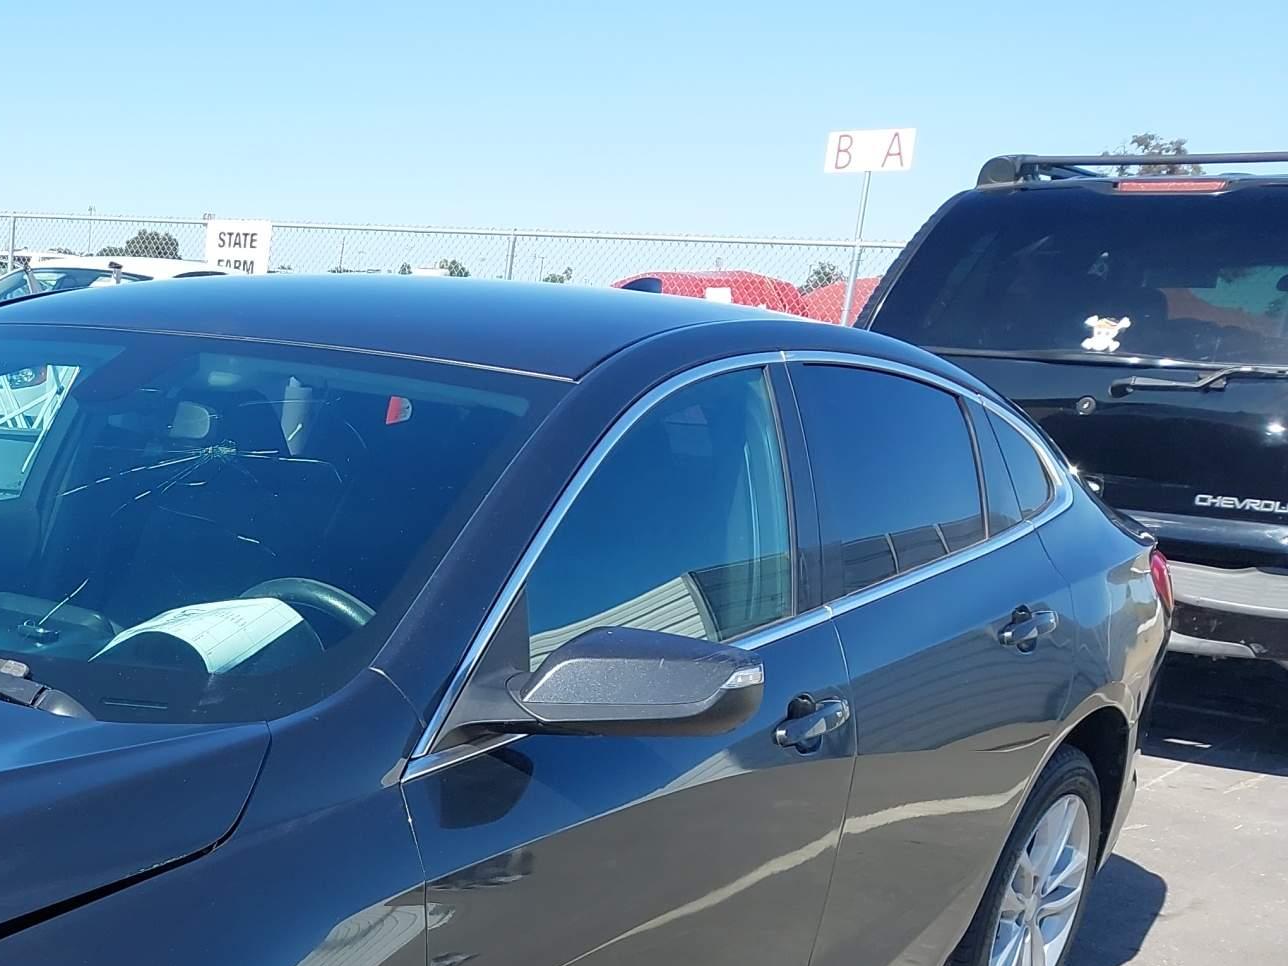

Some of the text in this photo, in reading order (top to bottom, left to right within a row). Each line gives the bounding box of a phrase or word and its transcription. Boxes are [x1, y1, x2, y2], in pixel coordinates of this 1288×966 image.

[835, 131, 904, 170] B A
[217, 231, 258, 249] STATE
